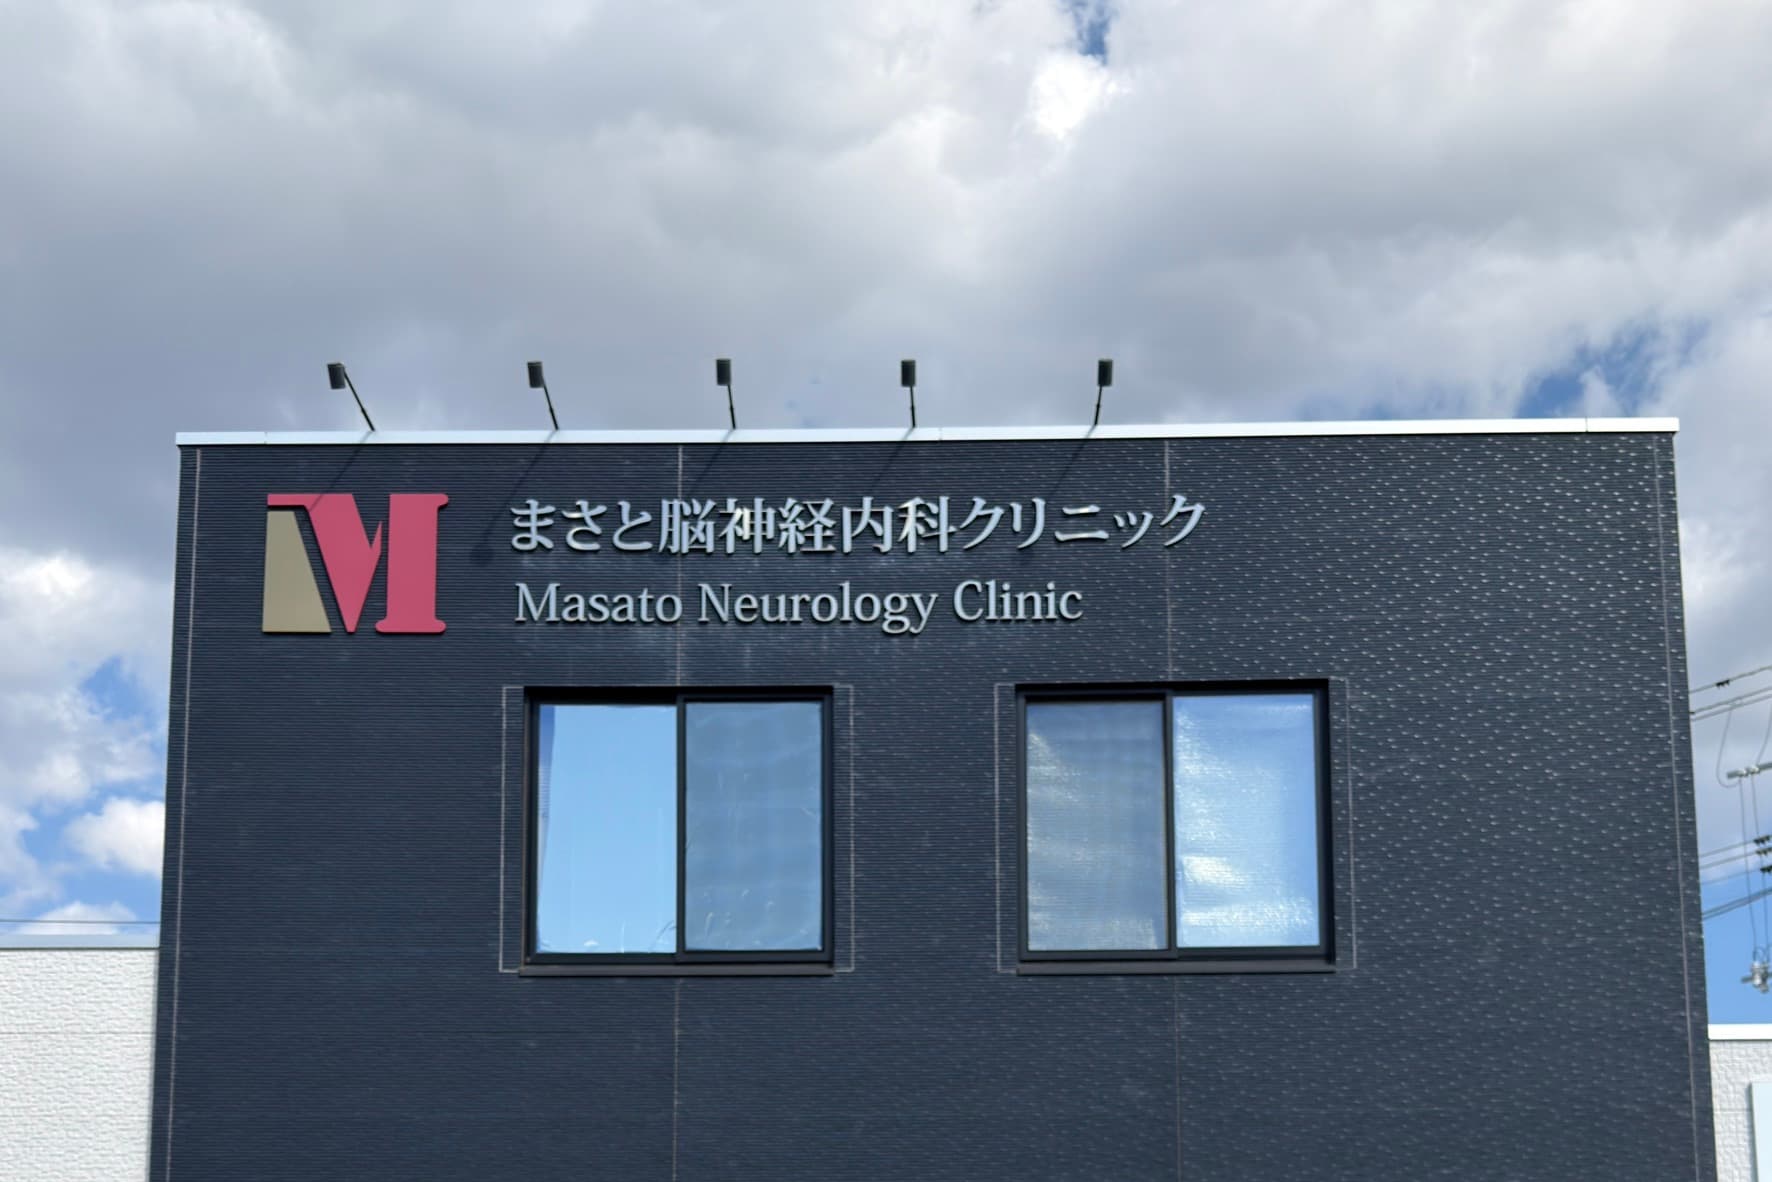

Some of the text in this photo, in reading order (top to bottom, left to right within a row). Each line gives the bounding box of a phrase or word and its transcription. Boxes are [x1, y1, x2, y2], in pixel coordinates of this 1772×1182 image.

[510, 494, 1206, 554] まさと脳神経内科クリニック
[514, 579, 1083, 634] Masato Neurology Clinic
